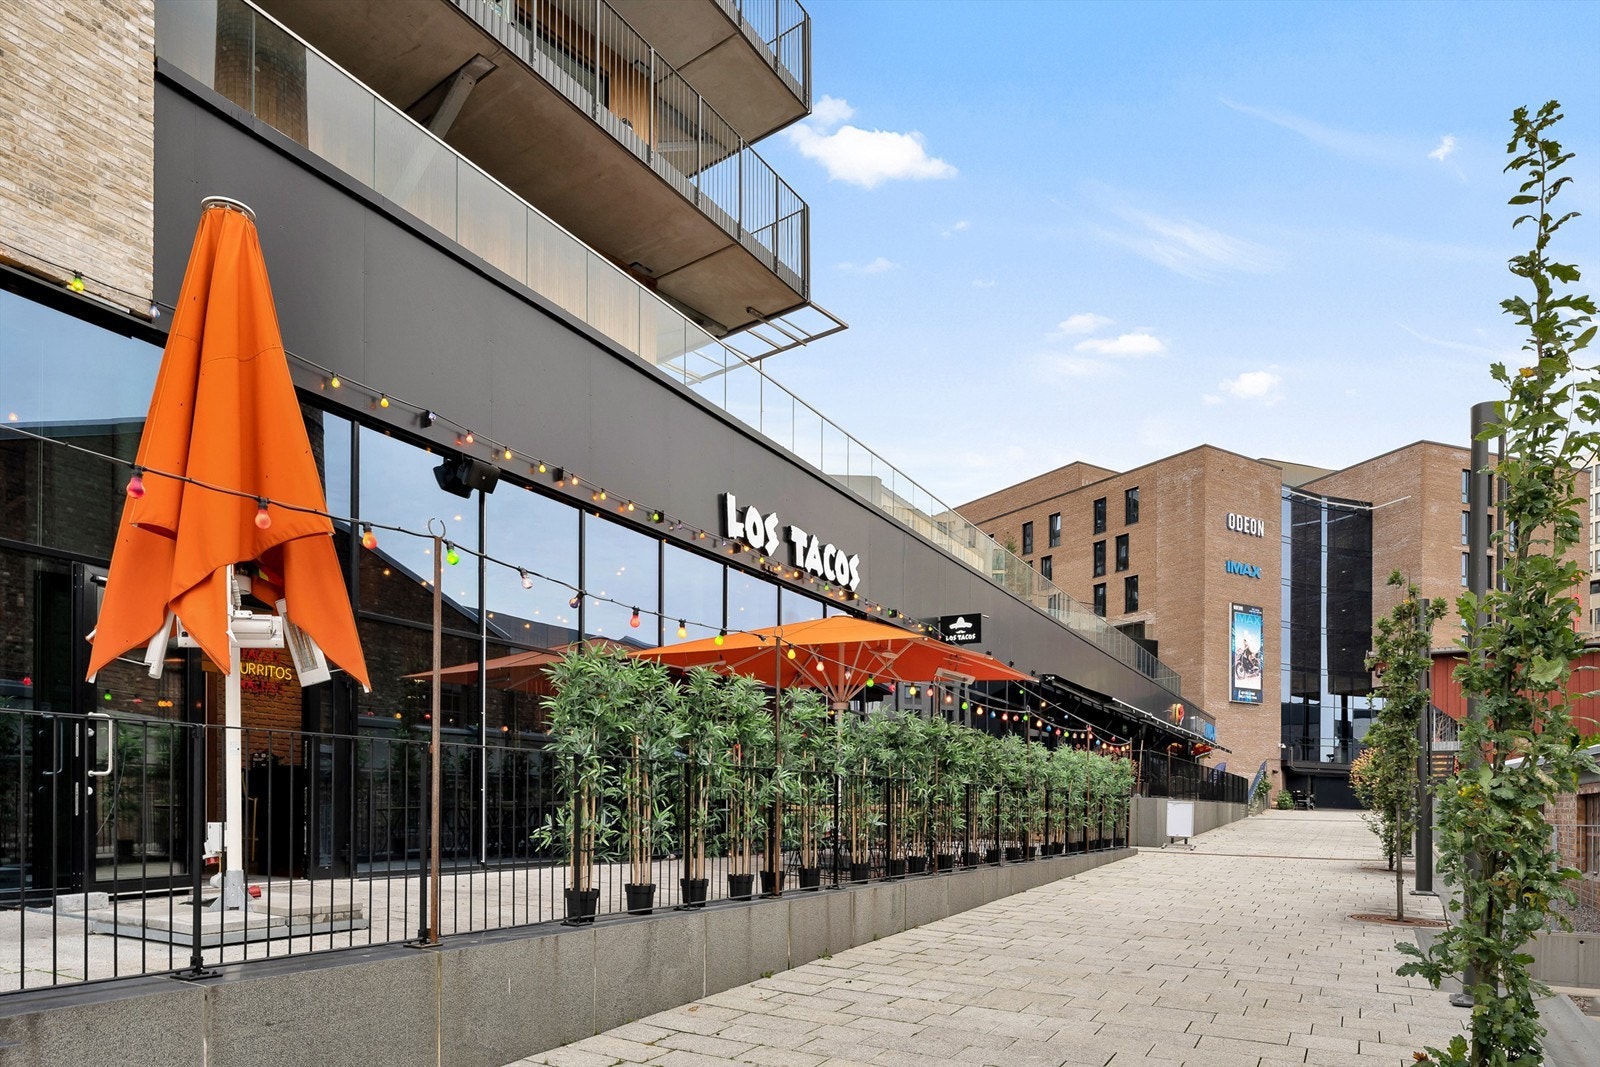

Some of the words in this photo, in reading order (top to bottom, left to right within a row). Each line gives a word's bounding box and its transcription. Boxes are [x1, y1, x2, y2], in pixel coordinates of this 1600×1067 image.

[1227, 512, 1265, 537] ODEON
[726, 491, 780, 557] LOS
[788, 525, 860, 592] TACOS
[1226, 560, 1262, 579] IMAX
[945, 634, 957, 642] LOS
[957, 633, 976, 641] TACOS
[240, 661, 293, 681] URRITOS
